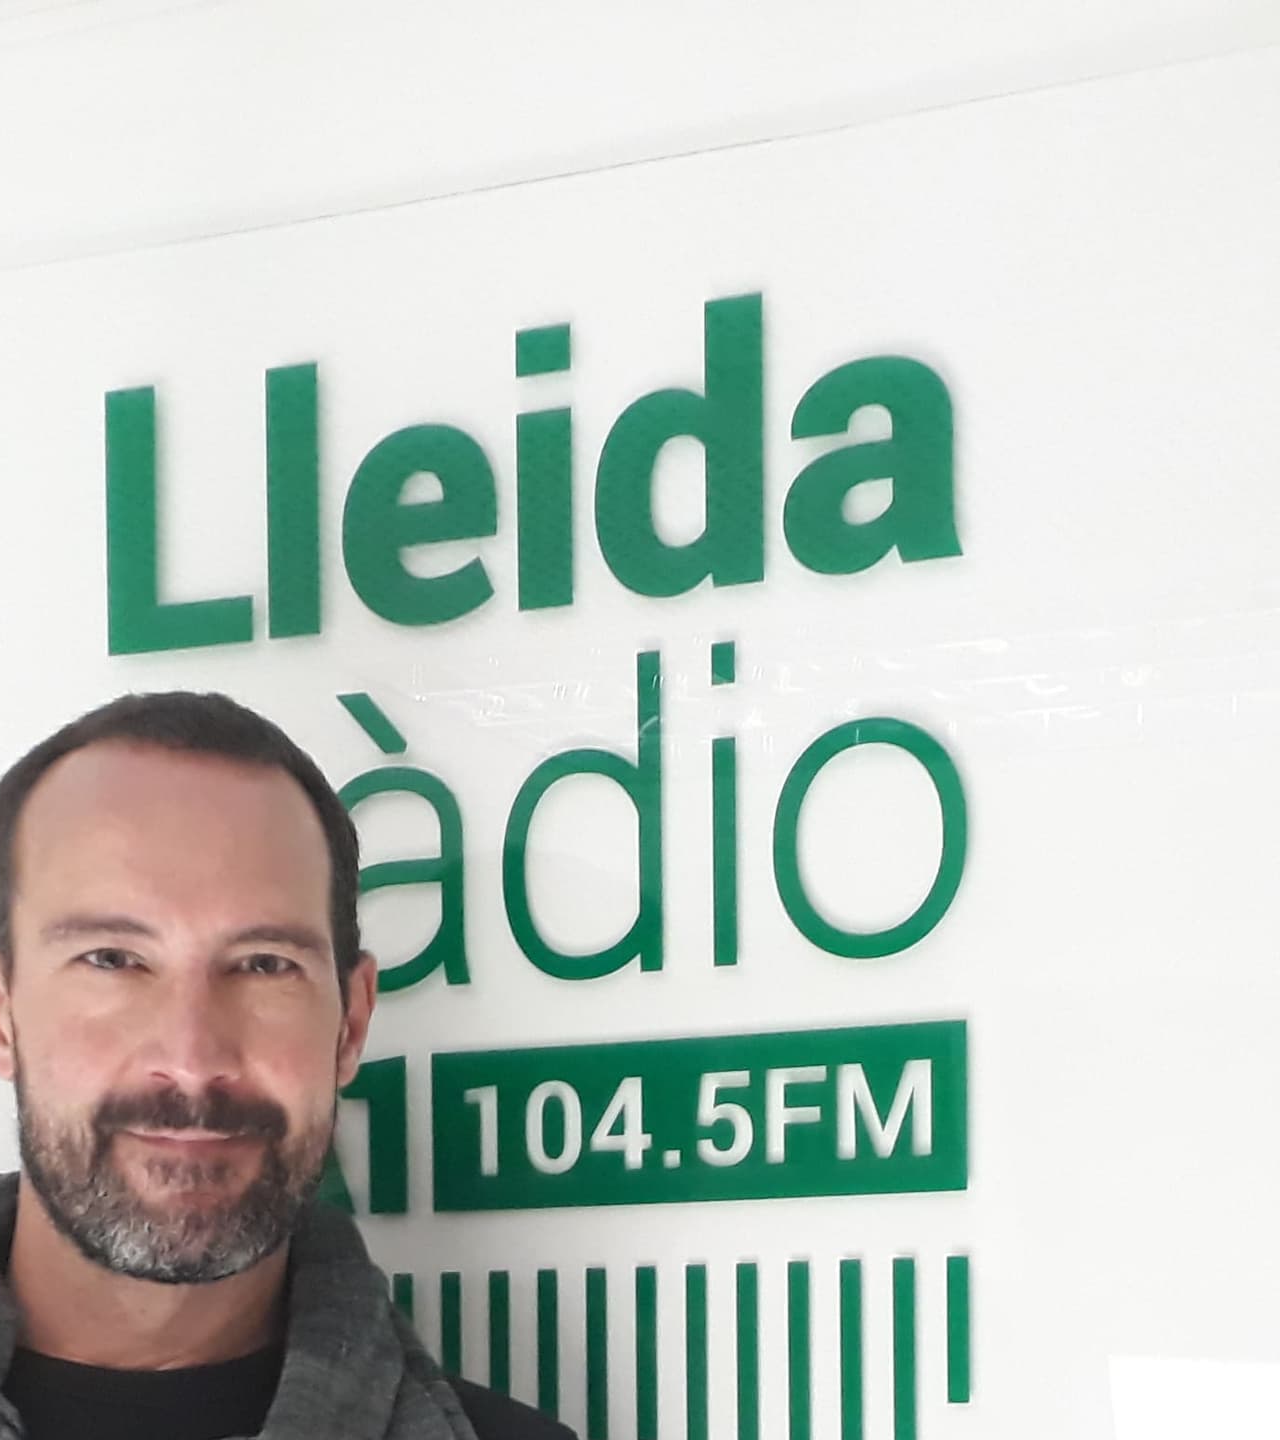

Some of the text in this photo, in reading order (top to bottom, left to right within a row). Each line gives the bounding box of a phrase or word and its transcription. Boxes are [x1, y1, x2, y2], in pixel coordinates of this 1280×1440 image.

[104, 292, 964, 657] Lleida
[337, 641, 971, 994] àdio
[463, 1058, 933, 1177] 104.5FM
